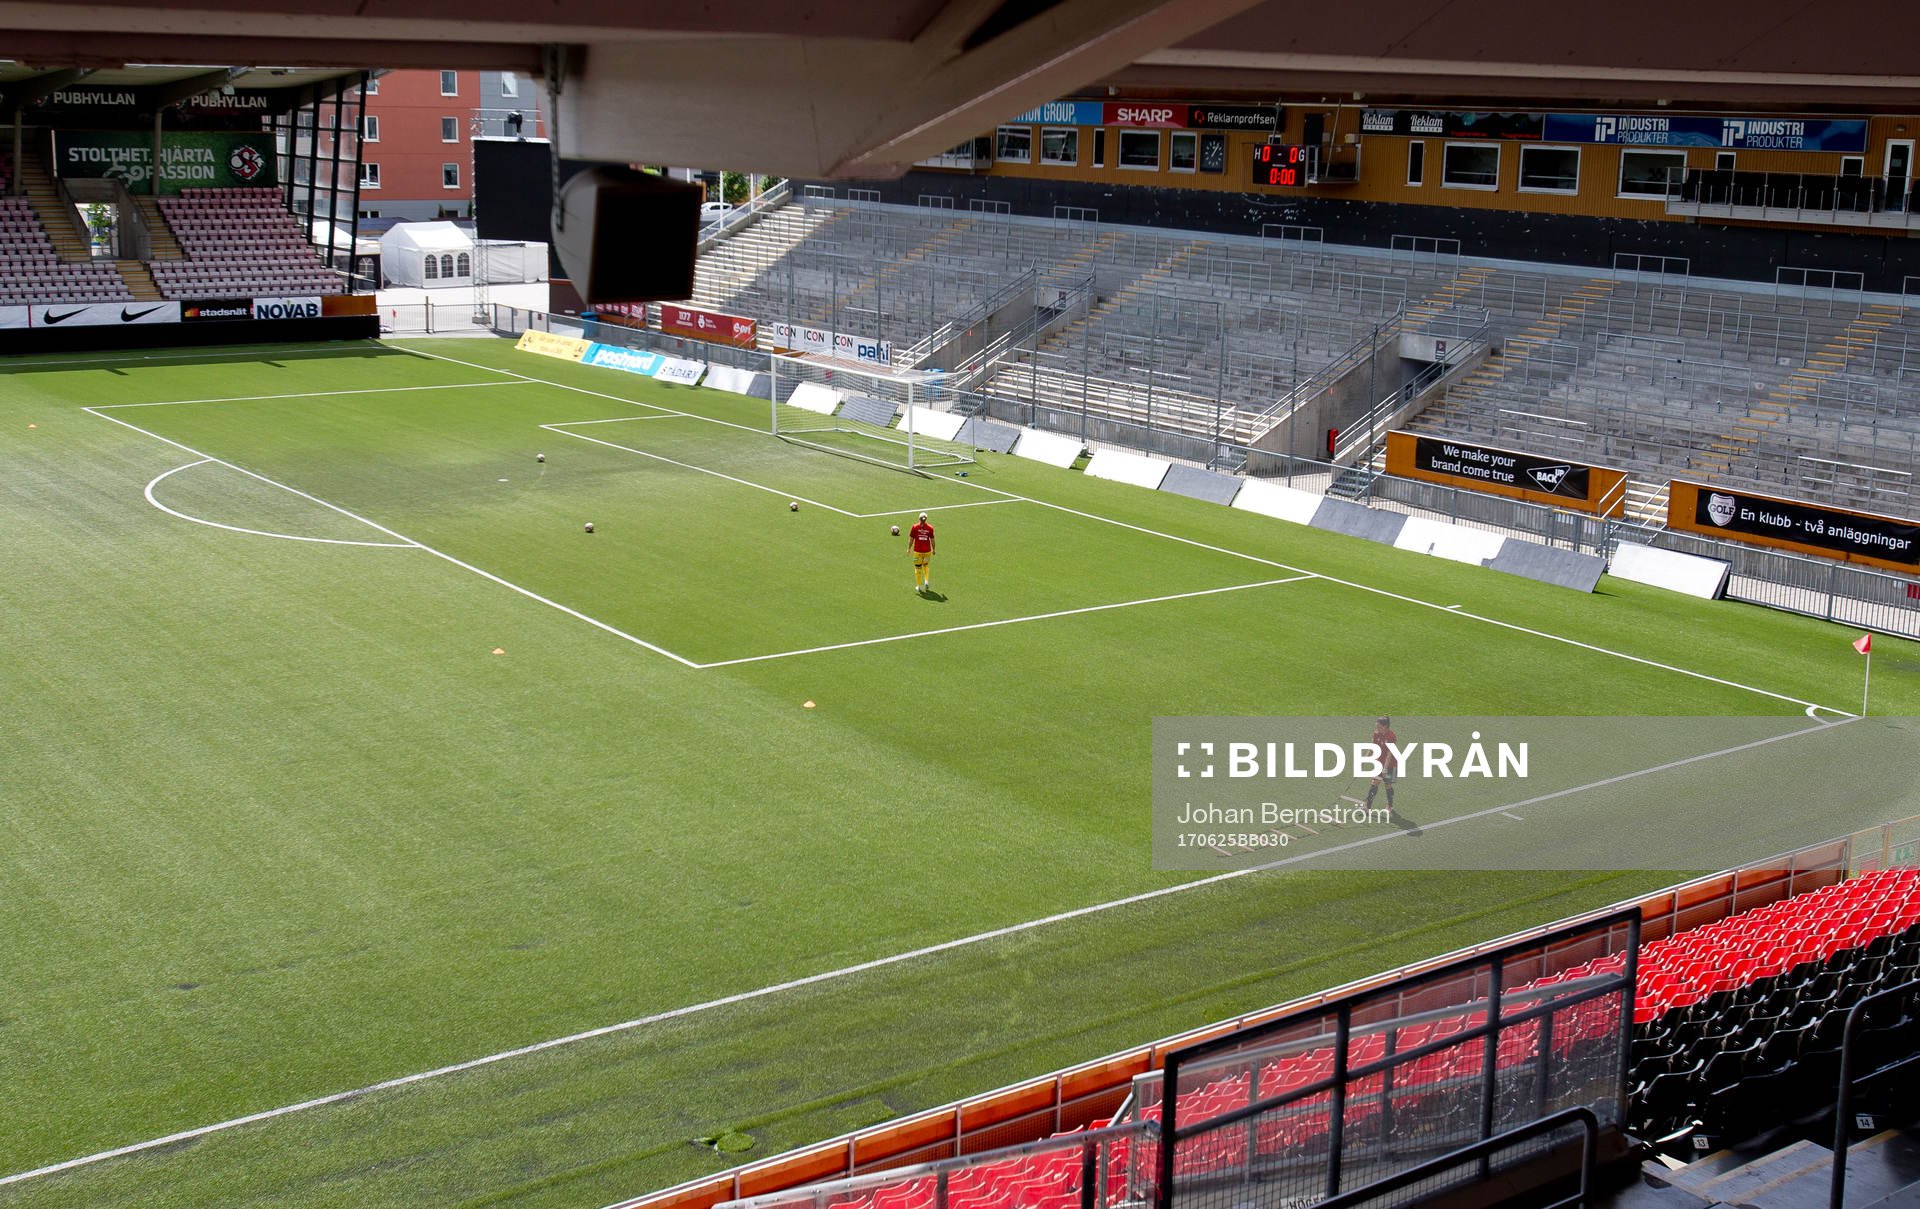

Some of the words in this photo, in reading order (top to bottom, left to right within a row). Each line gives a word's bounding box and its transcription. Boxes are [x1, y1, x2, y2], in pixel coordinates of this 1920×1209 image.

[53, 92, 136, 105] PUBHYLLAN
[1043, 103, 1075, 122] GROUP
[1117, 108, 1173, 122] SHARP
[1362, 112, 1394, 125] Reklam
[1410, 114, 1443, 127] Reklam
[1618, 118, 1669, 131] INDUSTRI
[1748, 121, 1805, 136] INDUSTRI
[1617, 131, 1668, 144] PRODUKTER
[1746, 135, 1803, 149] PRODUKTER
[1269, 167, 1296, 186] 0:00
[200, 308, 247, 317] stadsnät
[256, 303, 318, 319] NOVAB
[776, 326, 796, 338] ICON
[804, 329, 825, 342] ICON
[1443, 445, 1460, 458] We
[1461, 449, 1489, 462] make
[1491, 455, 1516, 468] your
[1431, 456, 1461, 472] brand
[1463, 464, 1490, 478] come
[1492, 470, 1515, 483] true
[1536, 471, 1558, 484] BACK
[1709, 503, 1735, 516] GOLF
[1740, 508, 1755, 521] En
[1759, 511, 1792, 528] klubb
[1804, 519, 1824, 534] två
[1828, 526, 1911, 549] anläggningar
